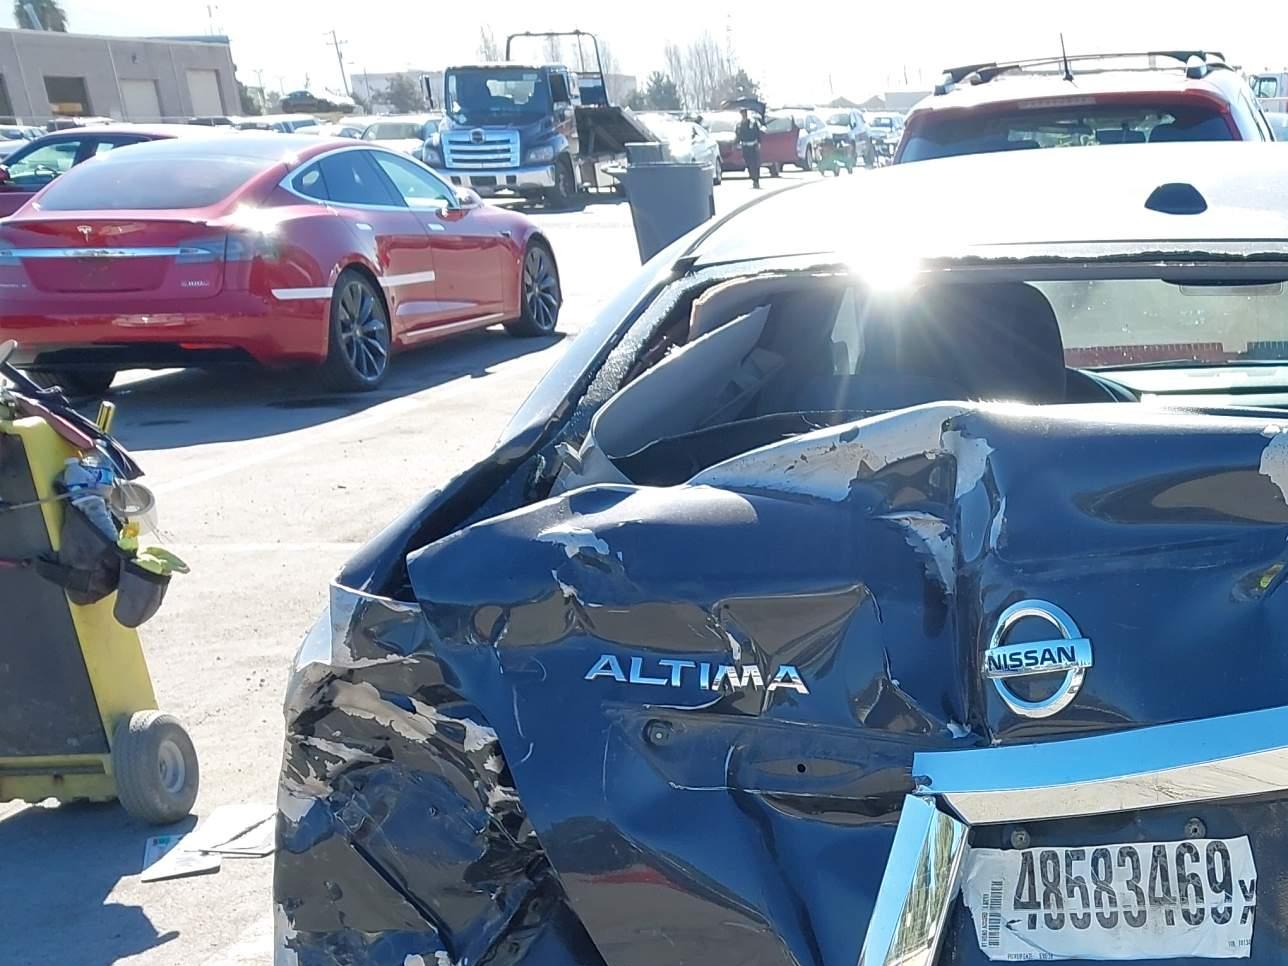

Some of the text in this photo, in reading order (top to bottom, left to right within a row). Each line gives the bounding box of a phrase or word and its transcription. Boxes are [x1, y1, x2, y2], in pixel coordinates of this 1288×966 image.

[585, 653, 810, 695] ALTIMA
[988, 645, 1076, 671] NISSAN
[1013, 840, 1233, 931] 48583469
